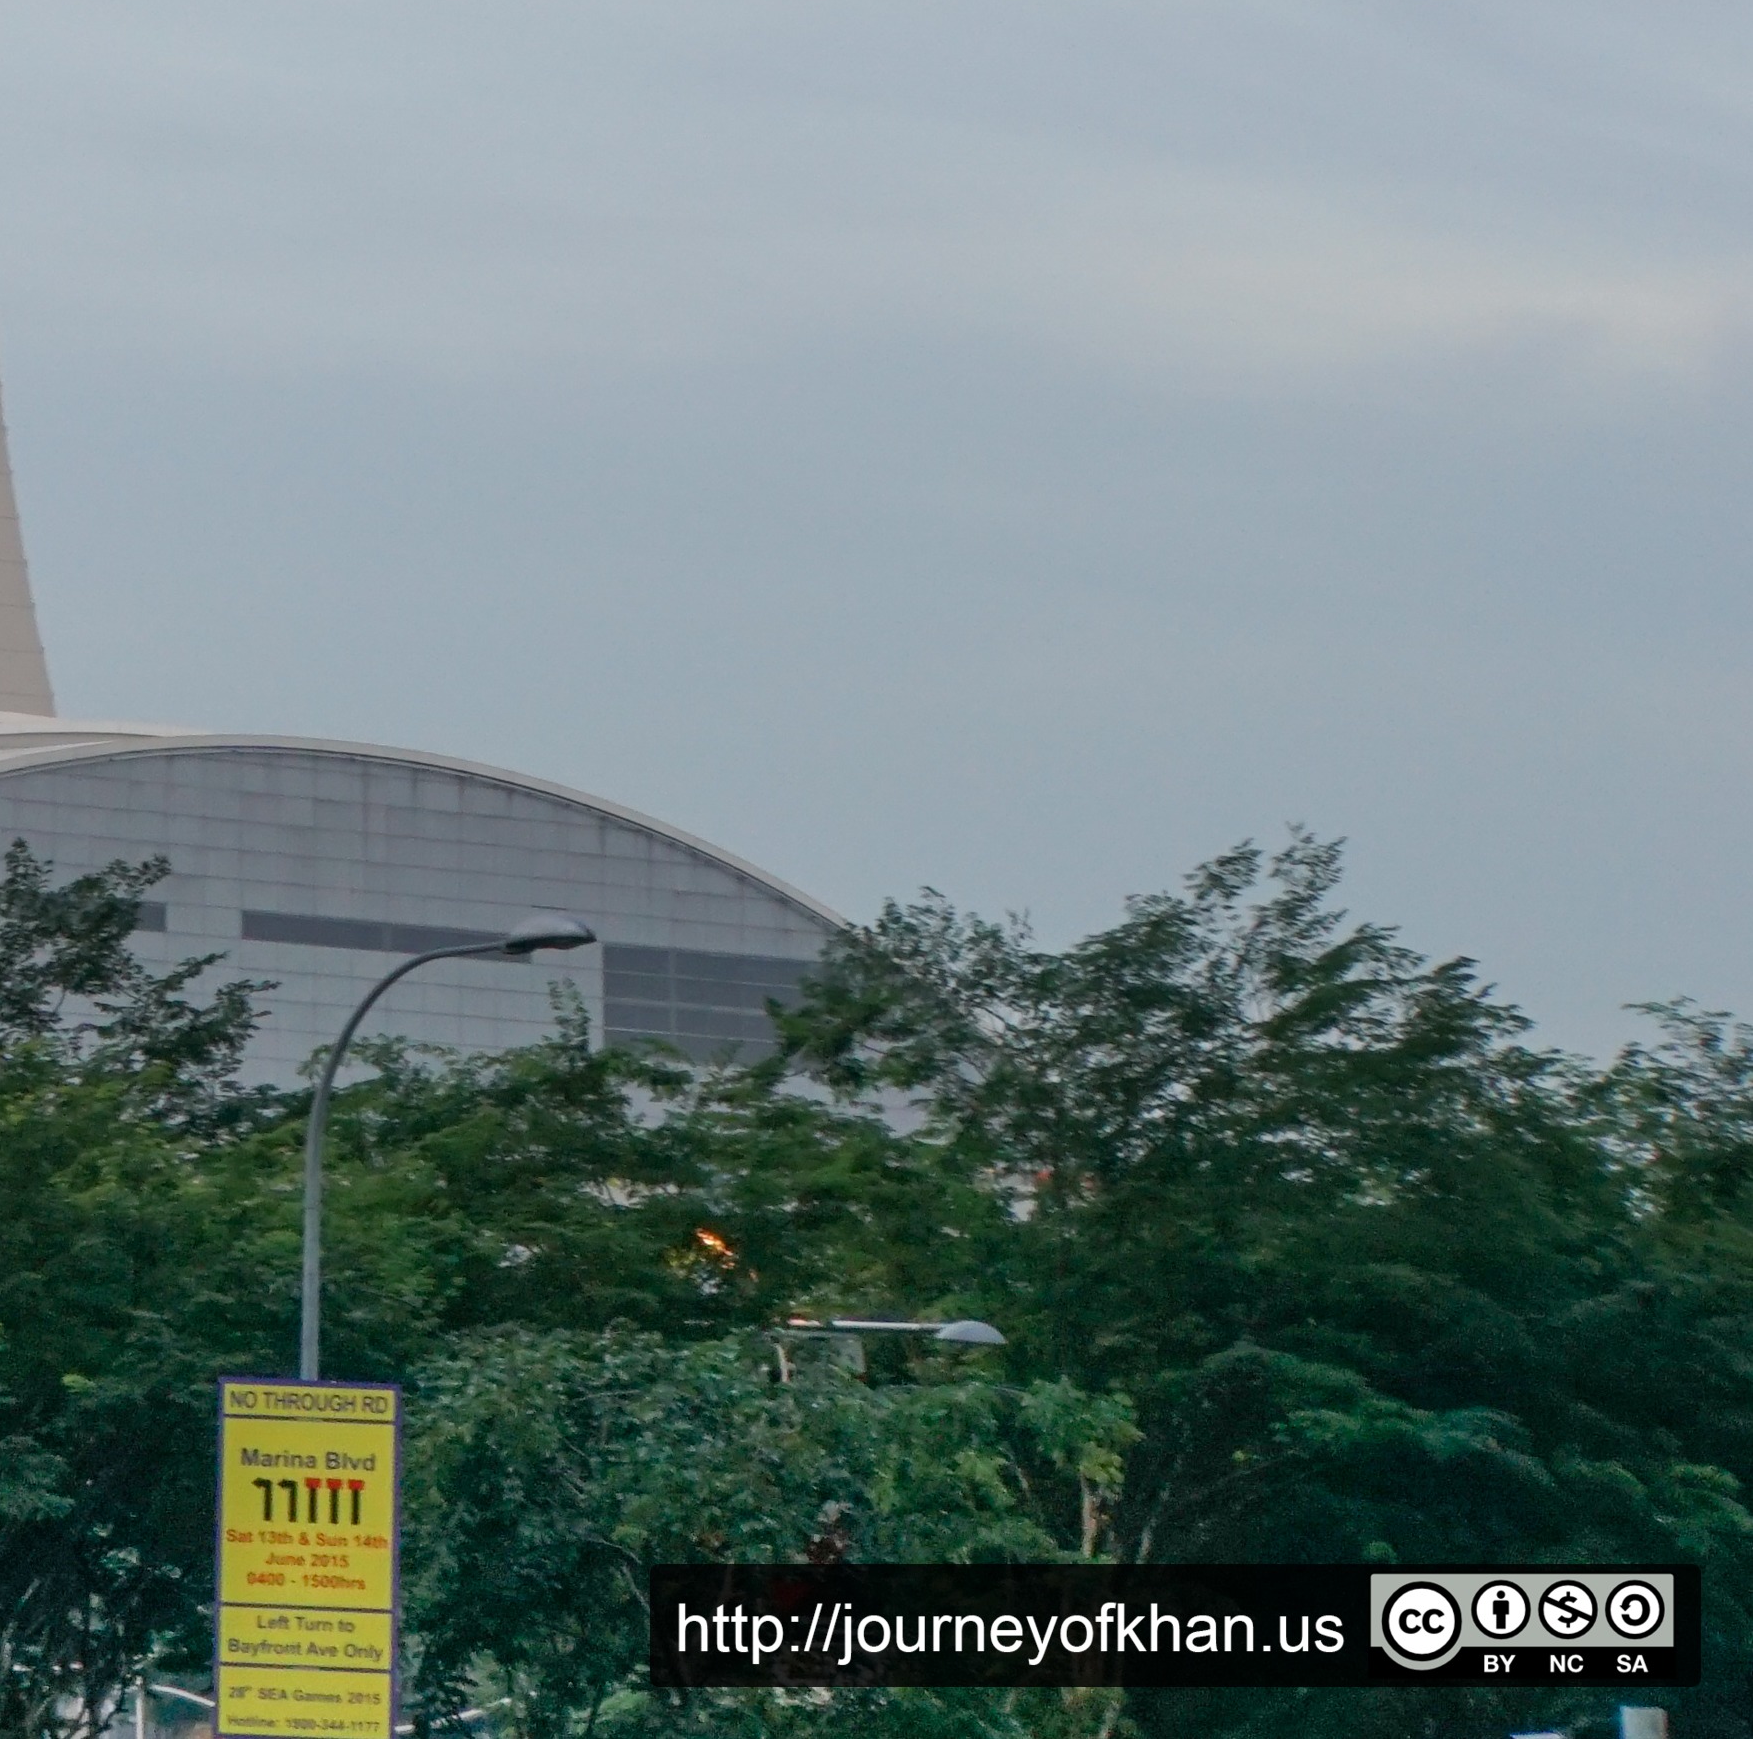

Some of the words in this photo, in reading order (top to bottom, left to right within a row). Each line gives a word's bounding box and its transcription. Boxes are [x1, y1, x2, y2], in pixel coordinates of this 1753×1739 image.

[230, 1390, 257, 1409] NO
[263, 1392, 357, 1412] THROUGH
[362, 1396, 388, 1414] RD
[241, 1447, 317, 1469] Marina
[326, 1451, 376, 1471] Blvd
[226, 1529, 253, 1543] Sat
[298, 1532, 310, 1546] &
[316, 1533, 348, 1547] Sun
[265, 1552, 305, 1566] June
[311, 1554, 350, 1568] 2015
[257, 1615, 289, 1630] Left
[295, 1616, 334, 1632] Turn
[338, 1619, 355, 1633] to
[228, 1638, 302, 1656] Bayfront
[306, 1642, 339, 1657] Ave
[344, 1644, 383, 1662] Only
[258, 1687, 287, 1700] SEA
[347, 1692, 381, 1705] 2015
